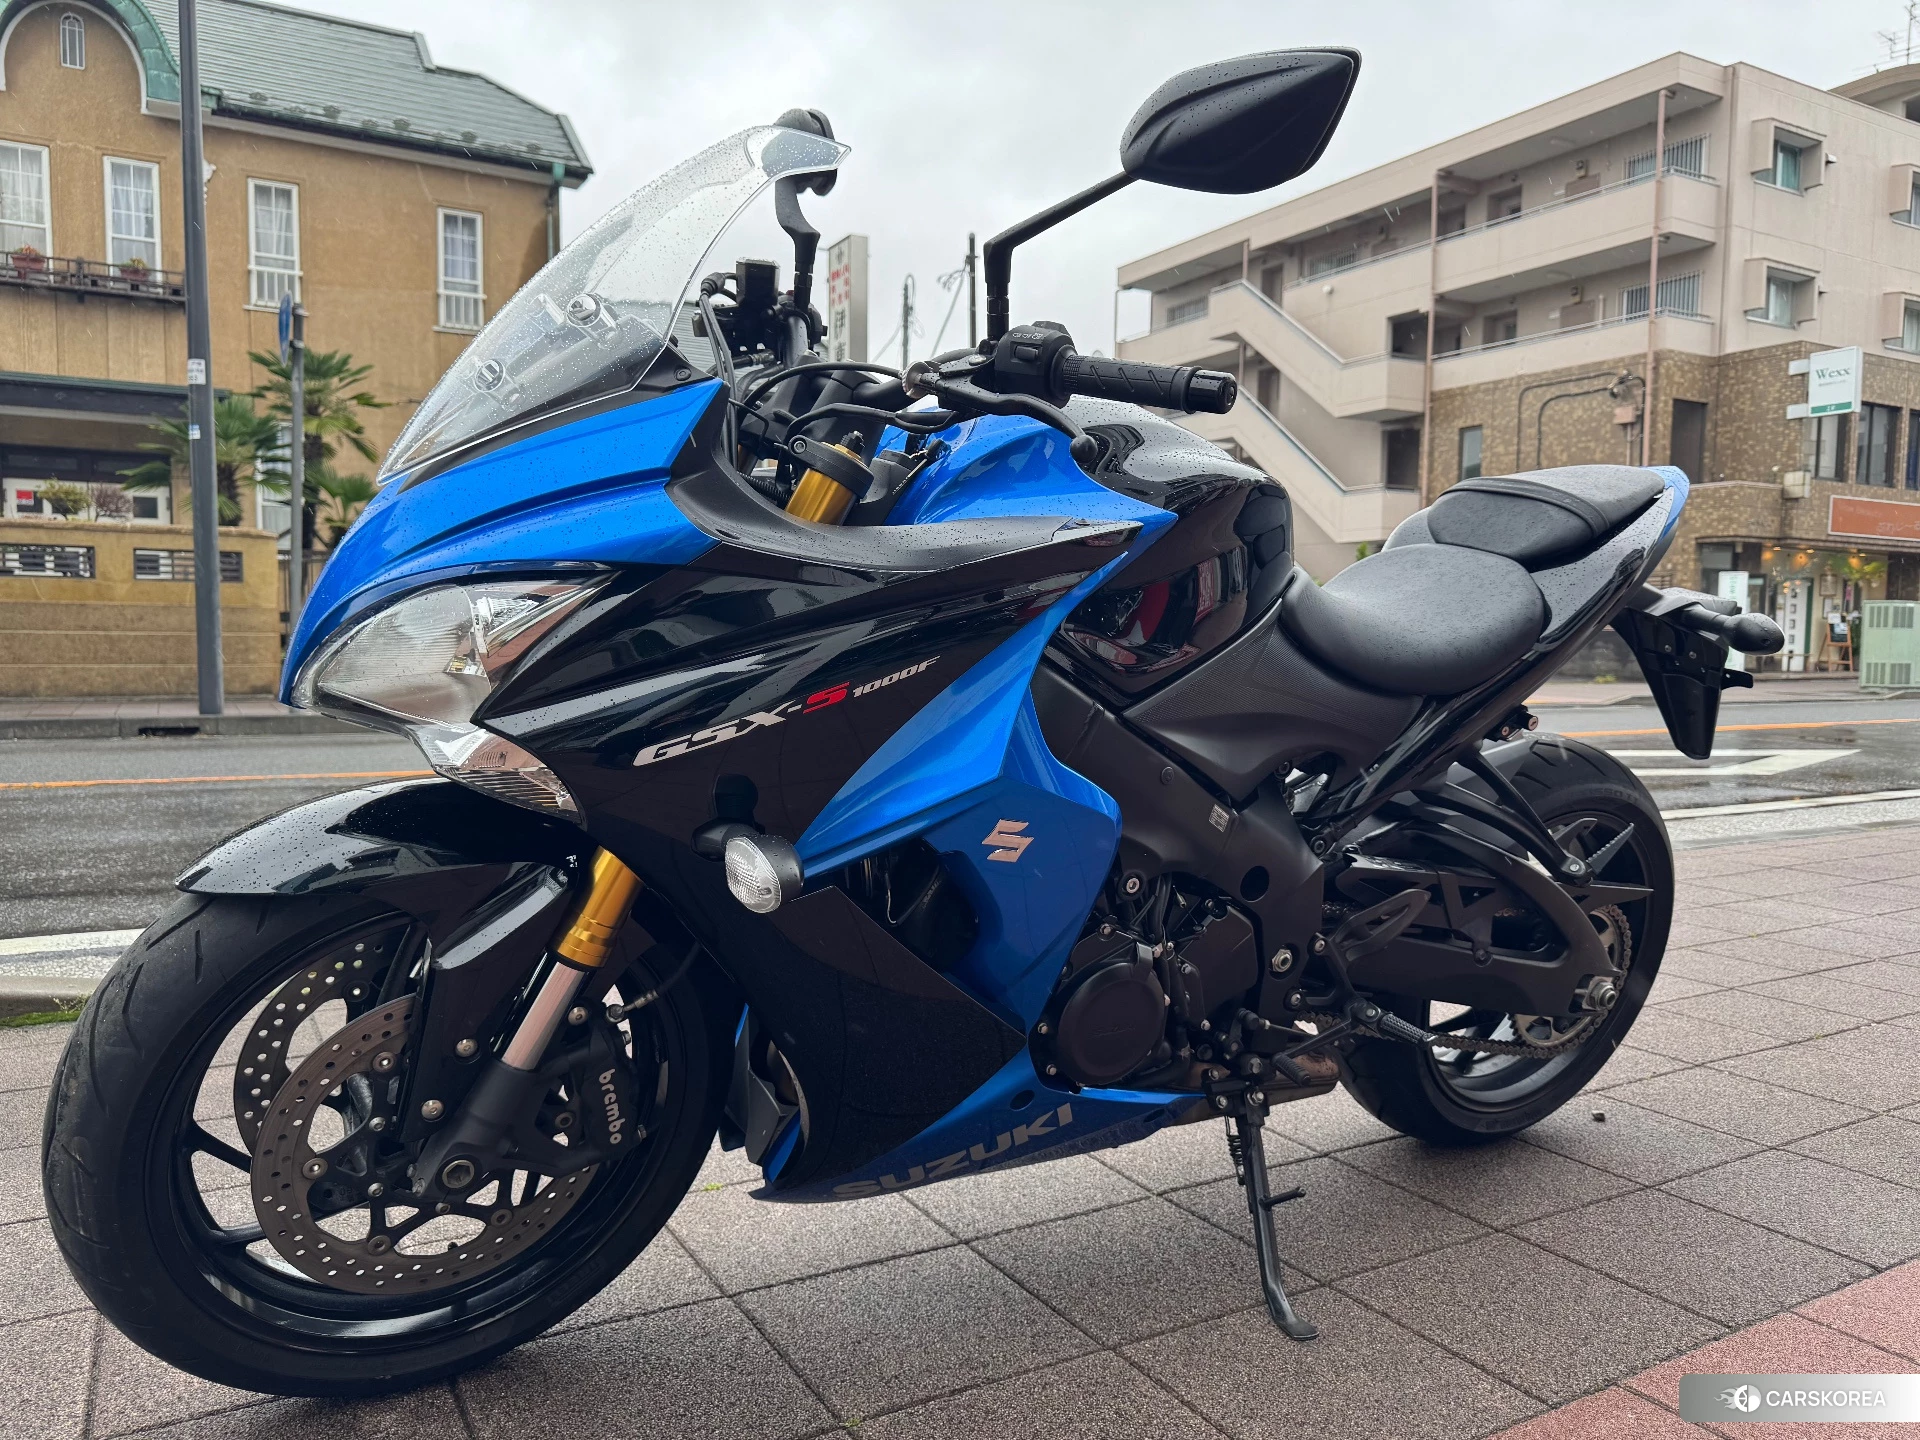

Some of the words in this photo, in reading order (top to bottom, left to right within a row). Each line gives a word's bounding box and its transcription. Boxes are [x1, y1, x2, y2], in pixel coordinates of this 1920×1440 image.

[1816, 367, 1851, 379] Wexx
[632, 682, 850, 767] GSX-S
[853, 655, 941, 698] 1000F
[599, 1068, 625, 1145] brembo
[832, 1102, 1074, 1198] SUZUKI
